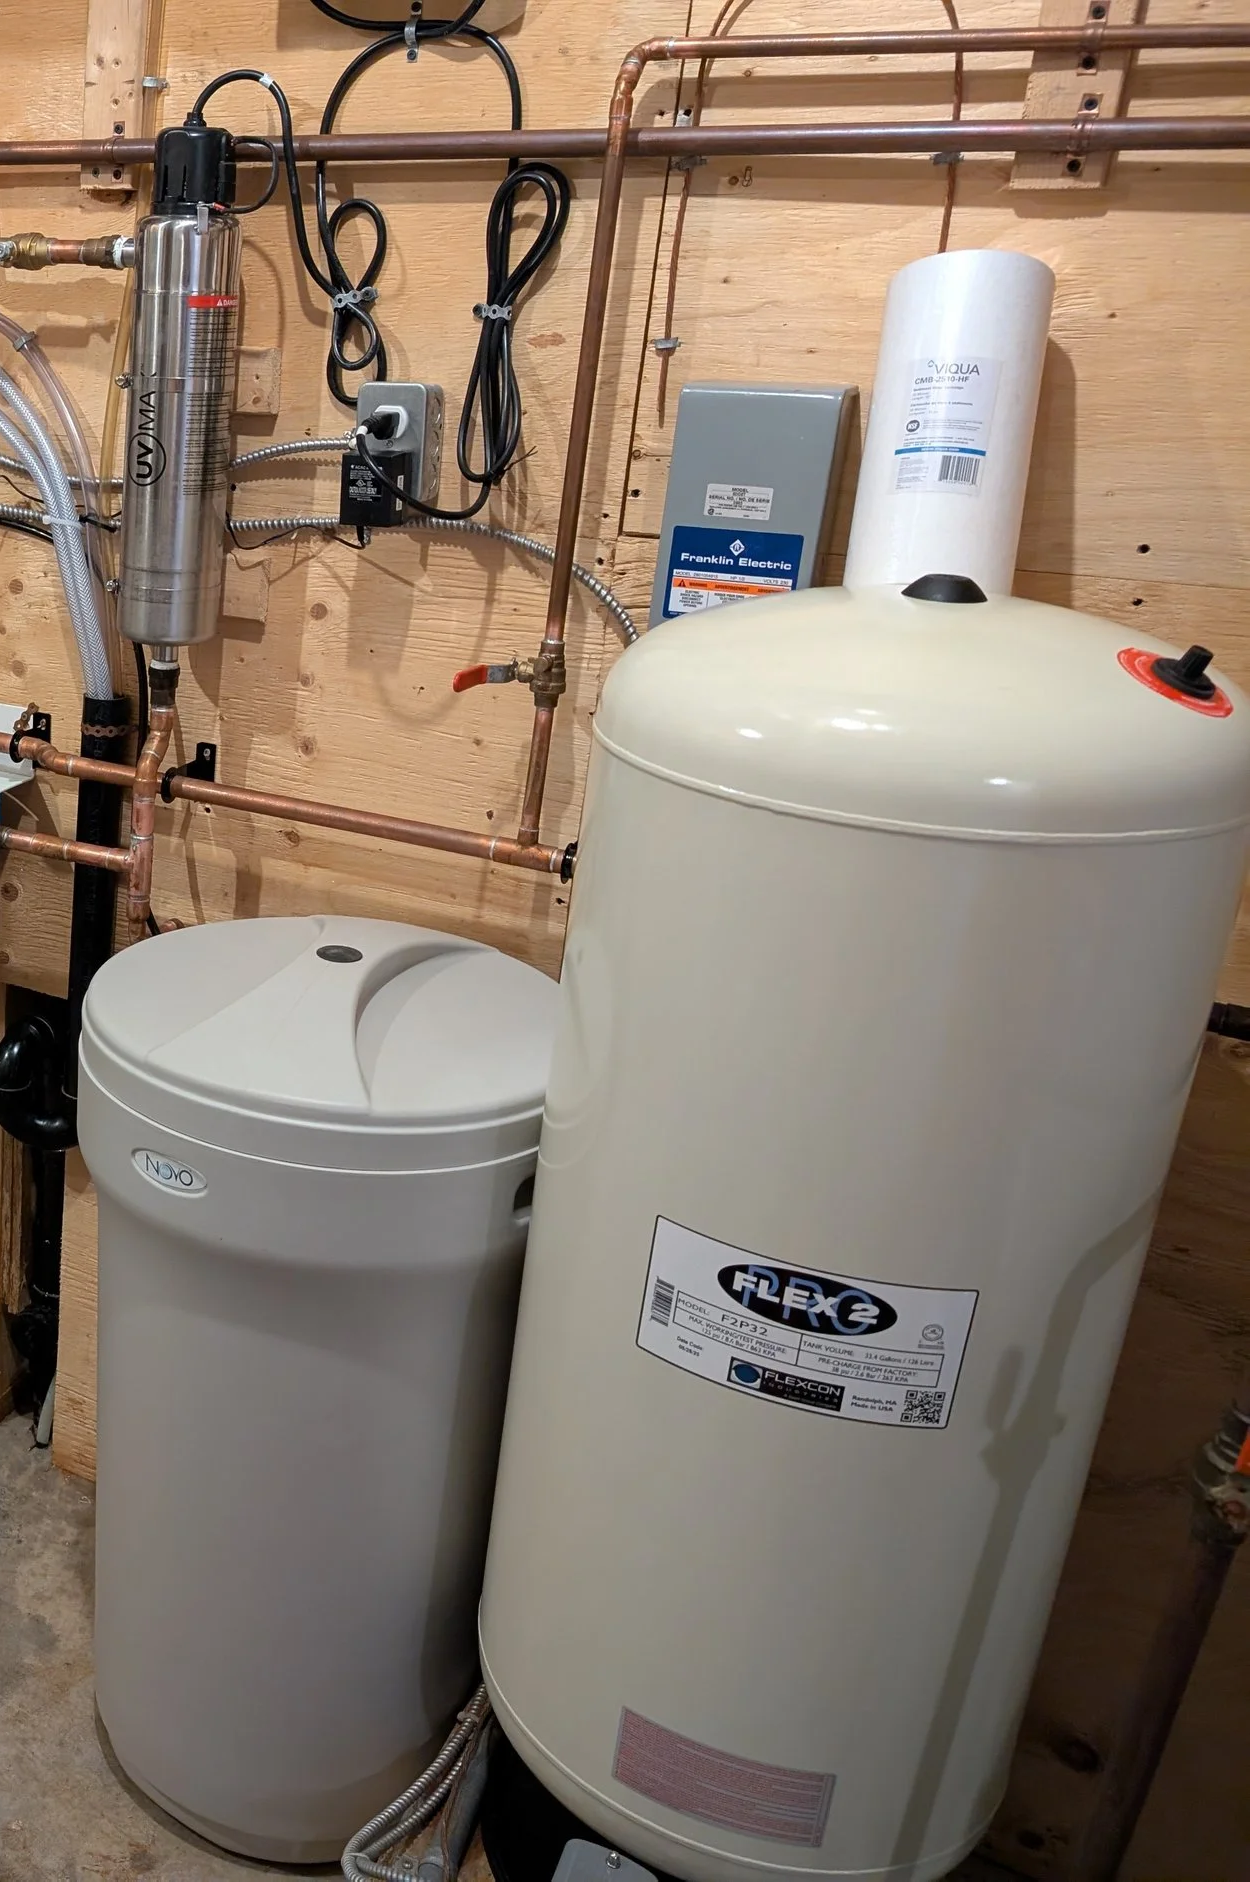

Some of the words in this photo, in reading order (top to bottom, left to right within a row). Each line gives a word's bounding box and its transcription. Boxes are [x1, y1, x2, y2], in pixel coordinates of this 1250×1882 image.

[935, 363, 980, 376] VIQUA
[680, 552, 734, 566] Franklin
[738, 557, 792, 571] Electric
[145, 1152, 194, 1187] NOVO
[732, 1270, 838, 1318] FLEX
[848, 1302, 880, 1325] 2
[721, 1313, 768, 1338] F2P32
[803, 1340, 823, 1351] TANK
[818, 1356, 861, 1371] PRE-CHARGE
[863, 1364, 883, 1375] FROM
[765, 1370, 841, 1396] FLEXCON
[850, 1401, 869, 1409] Made
